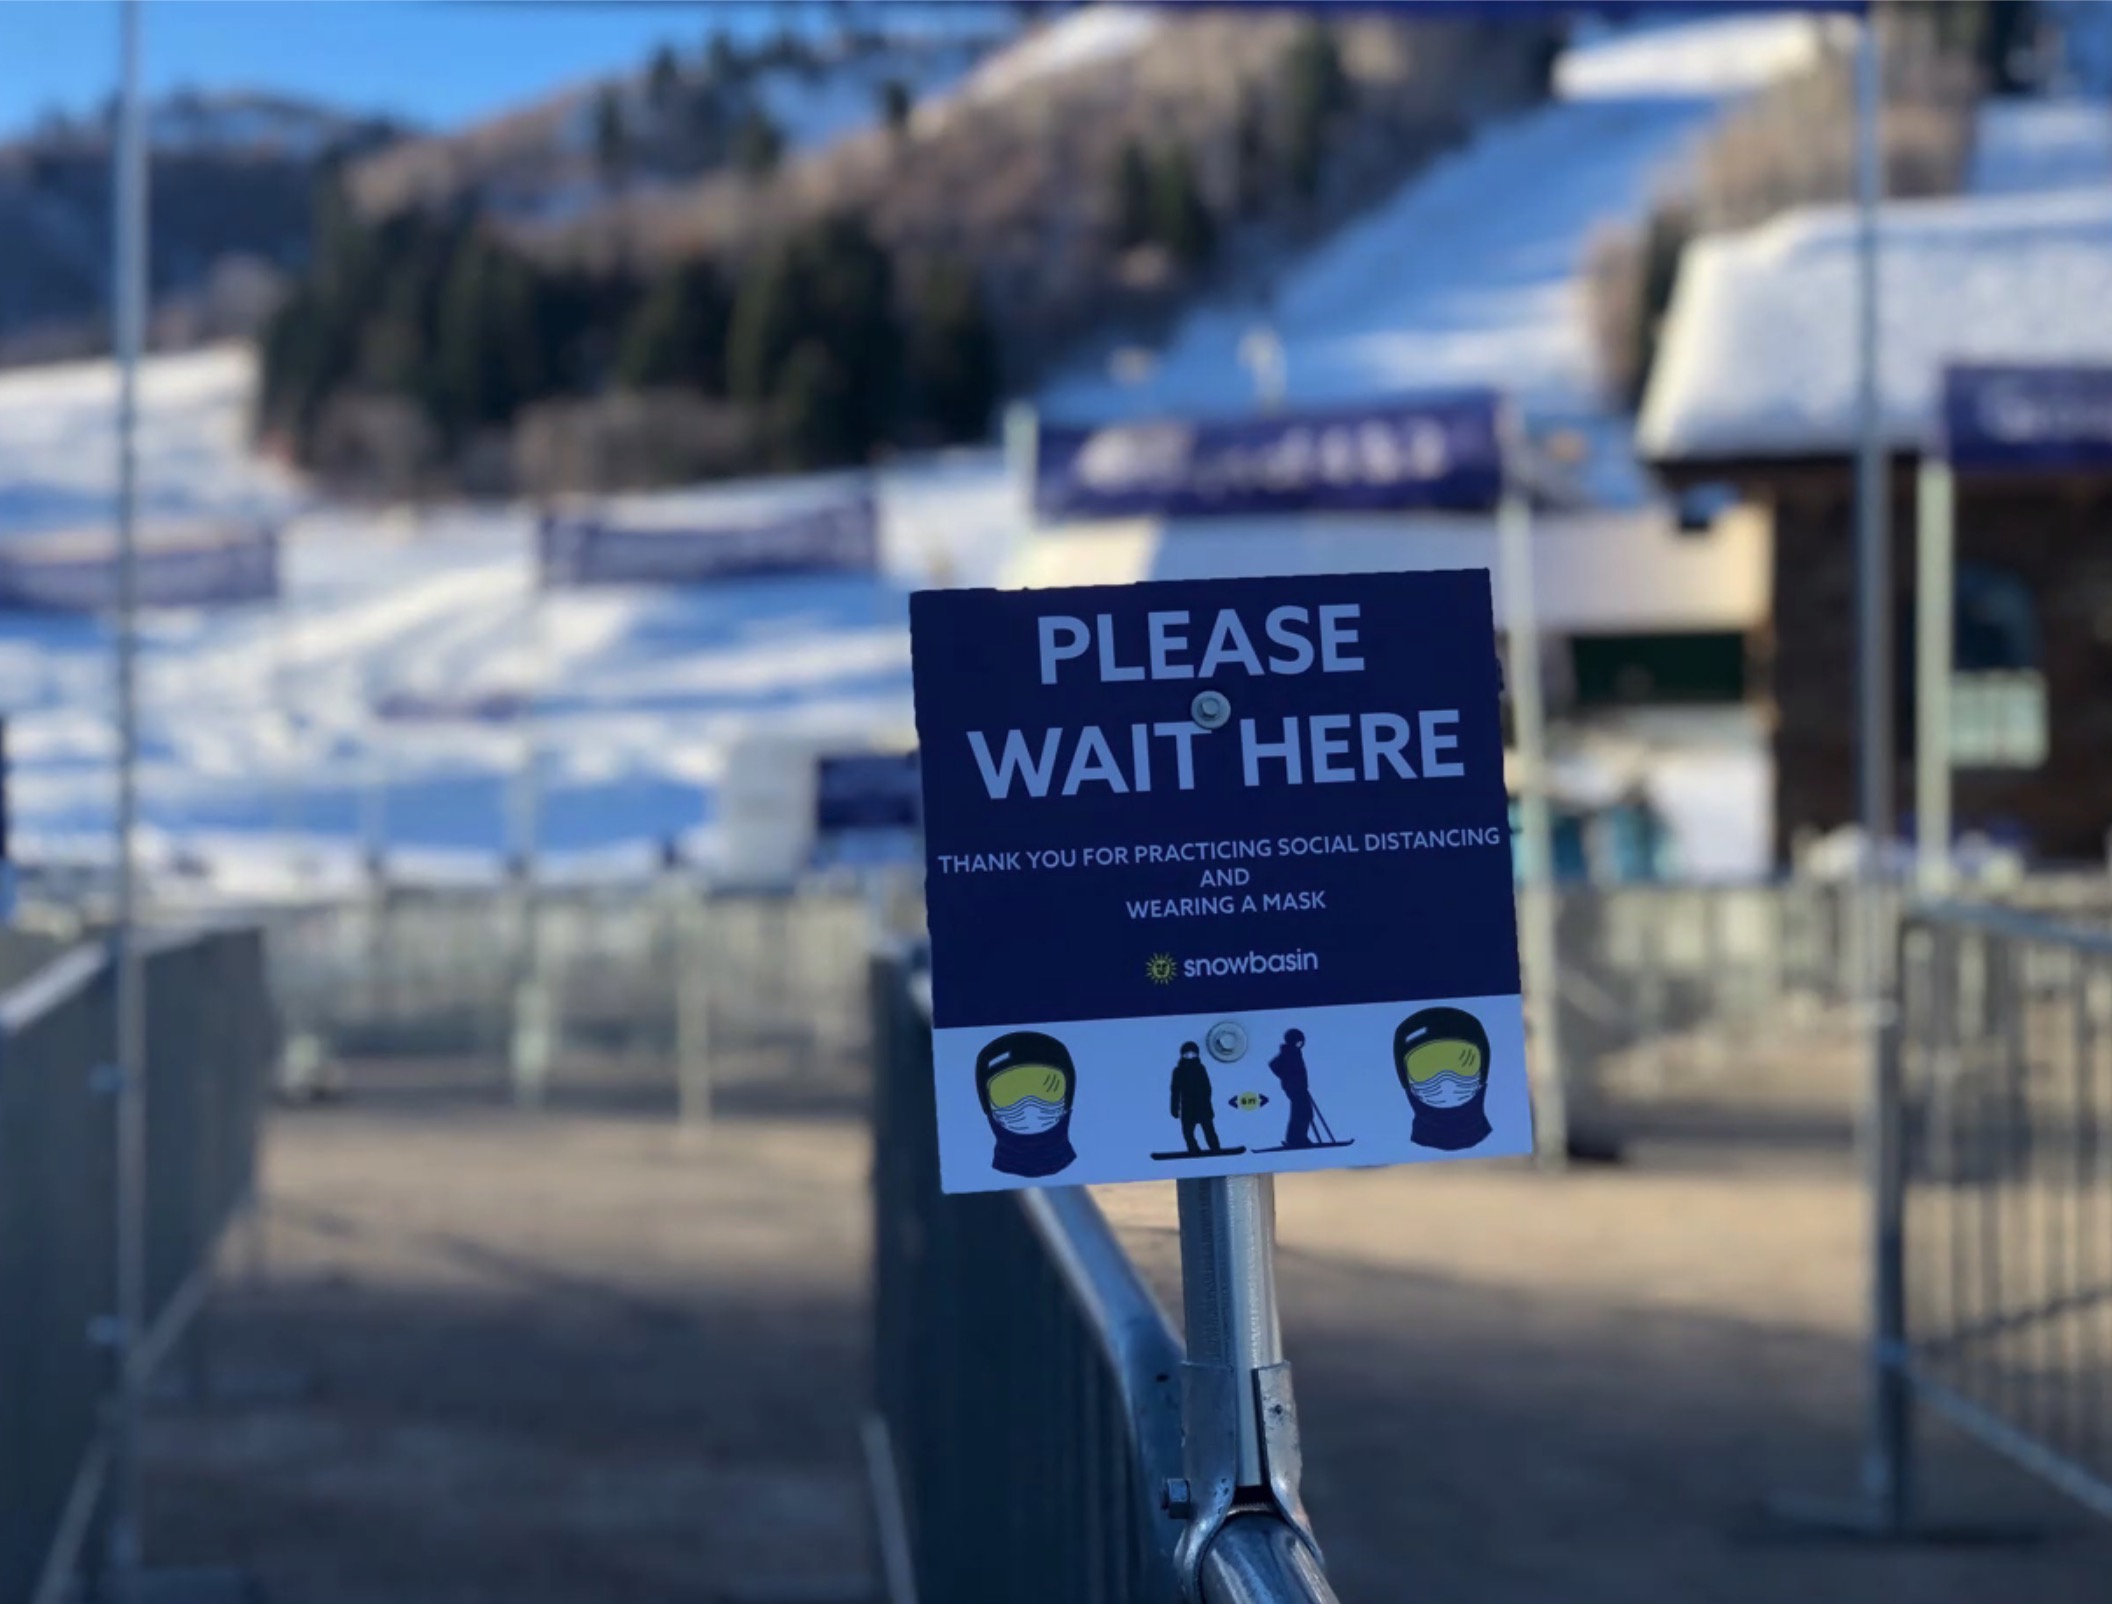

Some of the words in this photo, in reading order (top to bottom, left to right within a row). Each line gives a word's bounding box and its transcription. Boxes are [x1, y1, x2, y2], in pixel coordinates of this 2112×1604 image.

[1039, 604, 1364, 683] PLEASE
[967, 722, 1212, 799] WAIT
[1241, 710, 1464, 786] HERE
[937, 853, 1021, 874] THANK
[1026, 849, 1077, 869] YOU
[1083, 846, 1129, 867] FOR
[1134, 839, 1273, 864] PRACTICING
[1277, 832, 1361, 856] SOCIAL
[1364, 826, 1501, 852] DISTANCING
[1200, 867, 1251, 888] AND
[1126, 897, 1236, 919] WEARING
[1241, 894, 1258, 914] A
[1263, 890, 1327, 912] MASK
[1183, 948, 1320, 979] snowbasin
